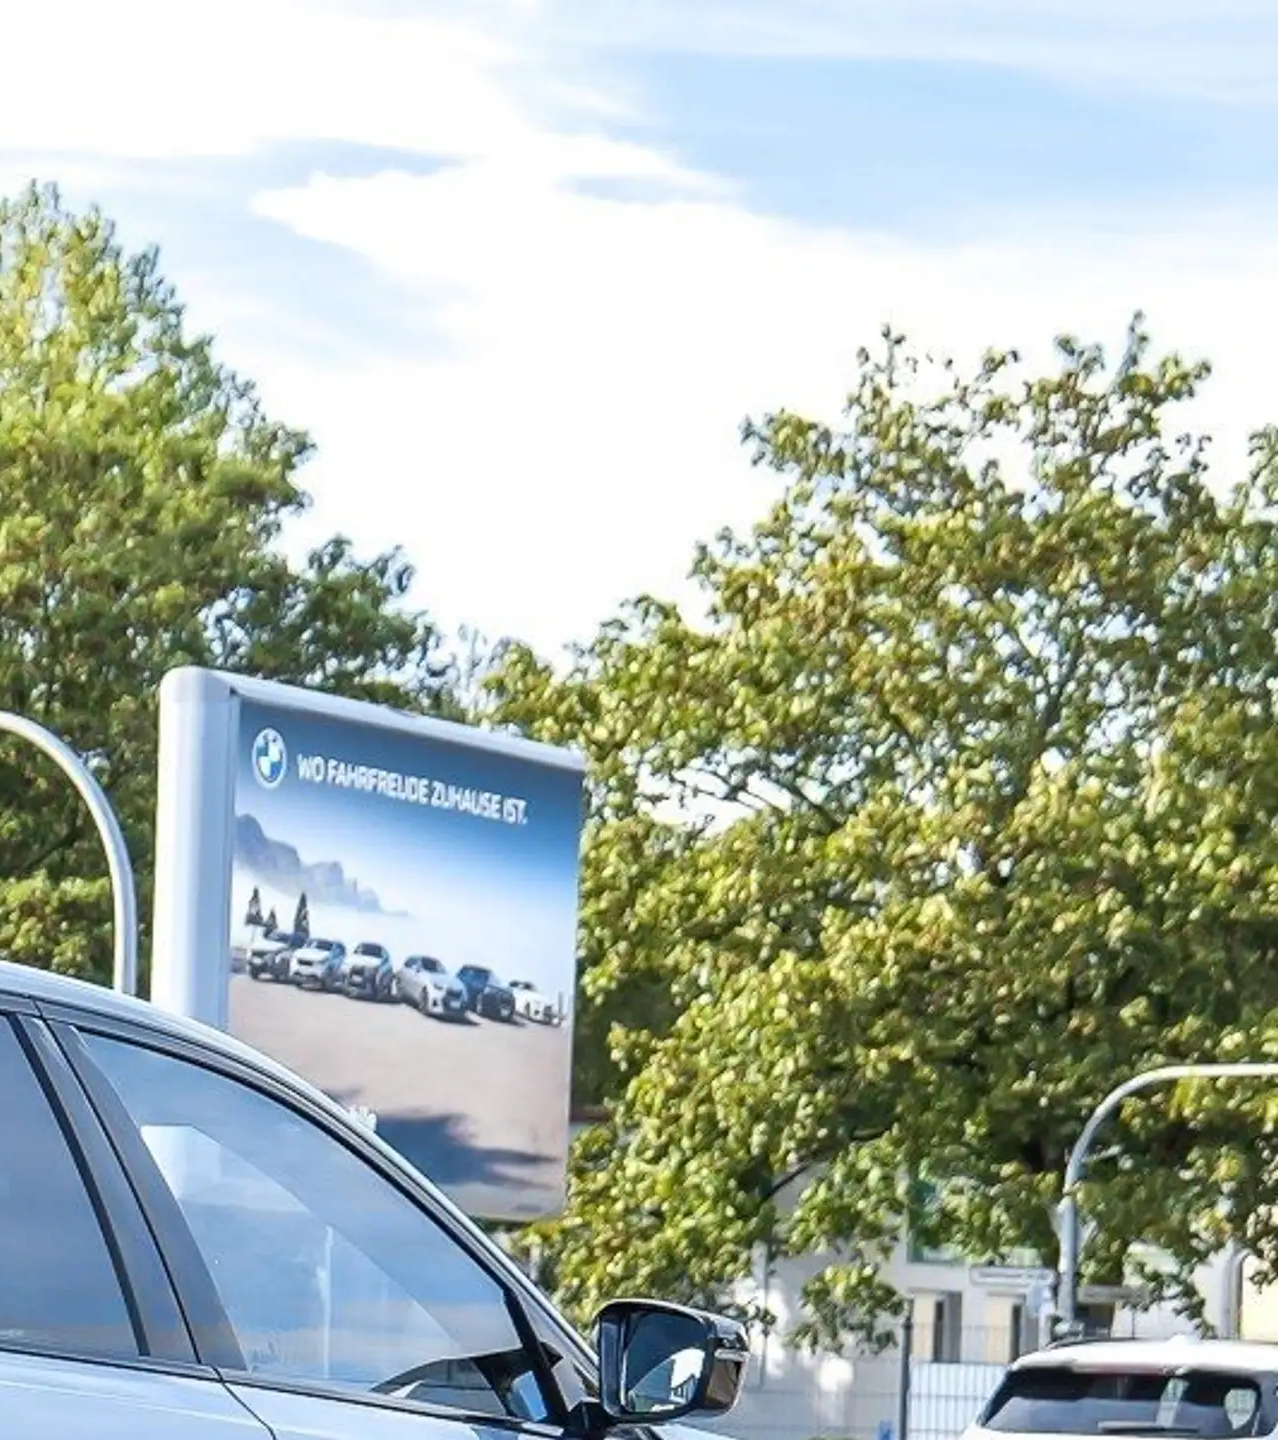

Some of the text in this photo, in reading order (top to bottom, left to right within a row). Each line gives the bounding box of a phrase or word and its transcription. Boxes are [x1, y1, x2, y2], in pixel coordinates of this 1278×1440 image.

[296, 753, 325, 784] WO
[327, 757, 430, 806] FAHRFREUDE
[430, 779, 501, 820] ZUHAUSE
